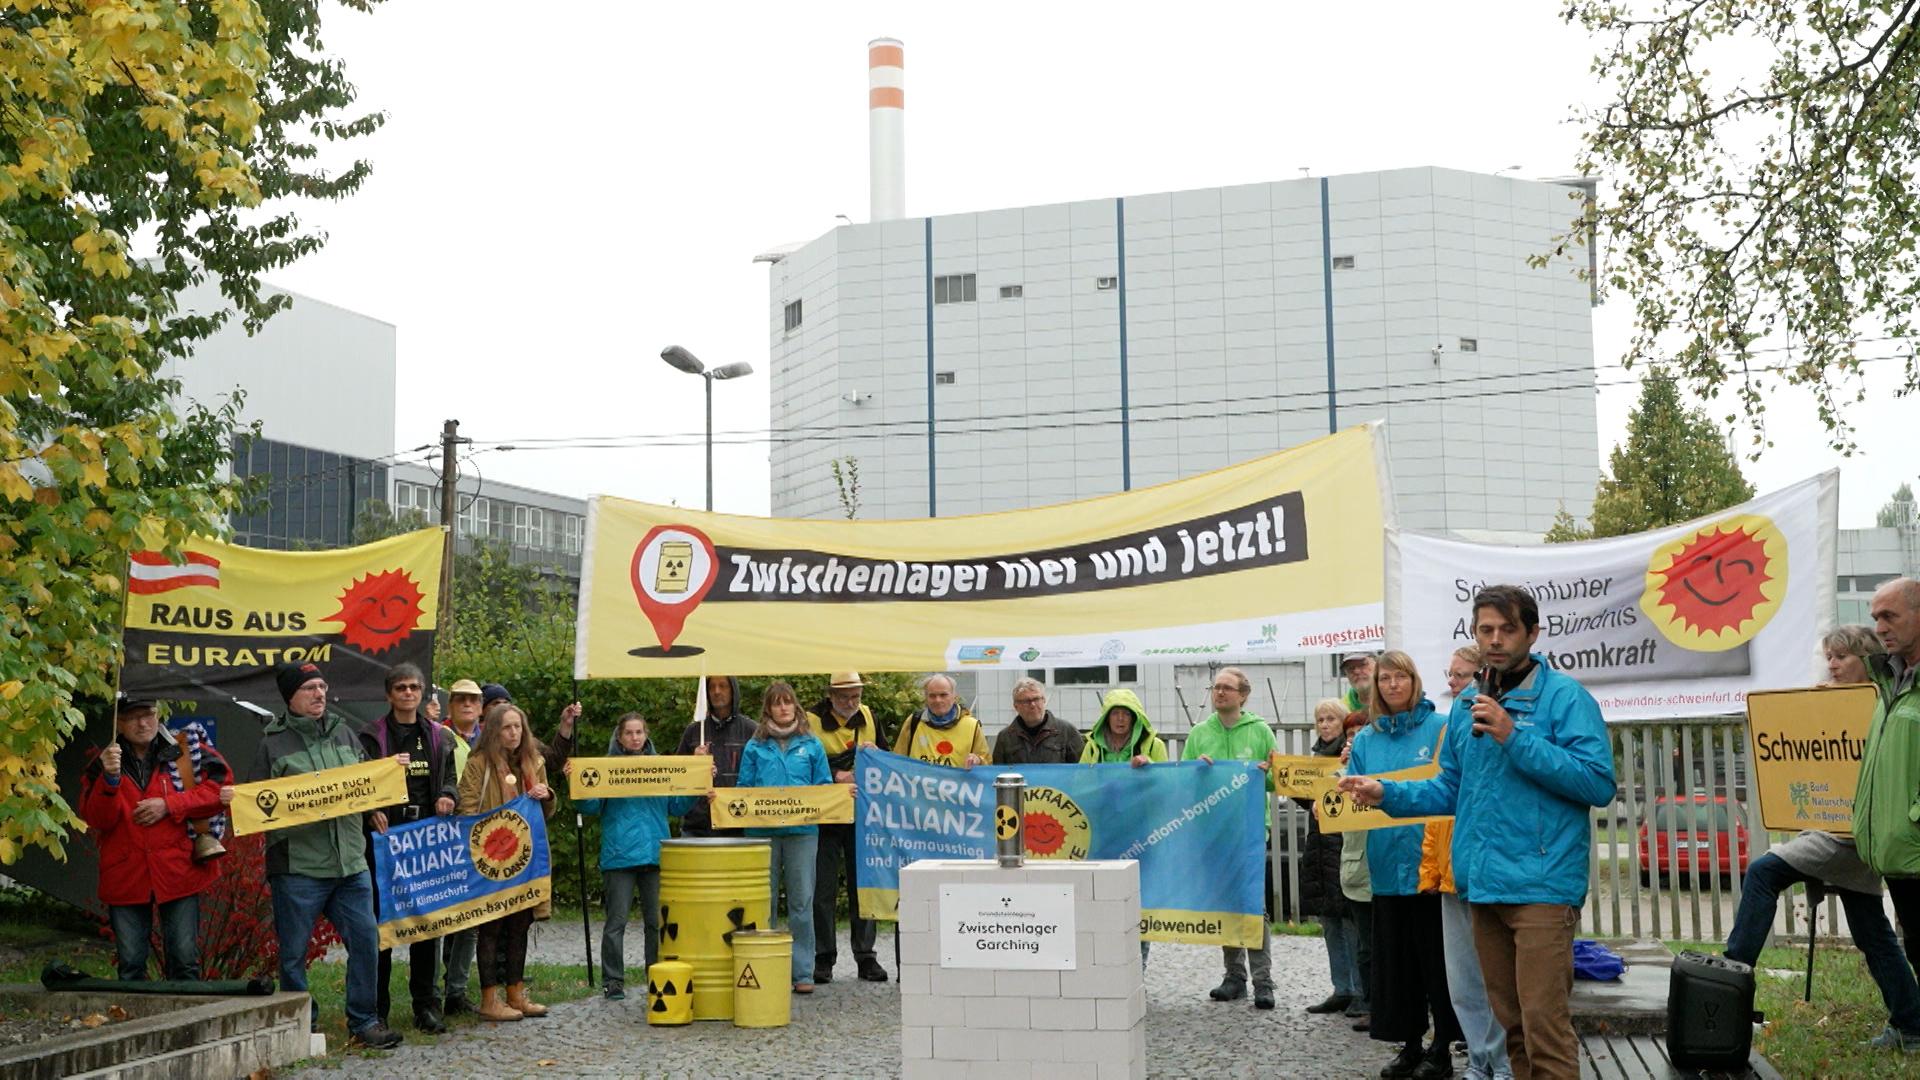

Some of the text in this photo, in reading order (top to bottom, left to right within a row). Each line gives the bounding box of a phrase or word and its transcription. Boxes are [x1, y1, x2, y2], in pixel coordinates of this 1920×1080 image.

[729, 554, 990, 598] Zwischenlager
[1089, 535, 1168, 581] und
[1177, 505, 1287, 575] jetzt!
[150, 603, 307, 632] RAUS AUS
[148, 642, 332, 667] EURATOM
[1538, 637, 1658, 671] tomkraft
[1757, 730, 1866, 762] Schweinfu
[608, 766, 688, 776] VERANTWORTUNG
[608, 776, 671, 786] ÜBERNEHMEN!
[864, 766, 985, 809] BAYERN
[288, 801, 305, 812] UM
[754, 798, 804, 806] ATOMMÜLL
[754, 807, 821, 816] ENTSCHÄRFEN!
[1119, 771, 1250, 860] anti-atom-bayern.de
[865, 801, 985, 839] ALLIANZ
[388, 821, 462, 857] BAYERN
[865, 833, 985, 861] für Atomausstieg
[392, 845, 466, 881] ALLIANZ
[476, 843, 532, 878] NEIN DANKE
[865, 854, 893, 868] und
[391, 868, 469, 896] für Atomausstieg
[394, 883, 470, 913] und Klimaschutz
[395, 886, 541, 939] www.anti-atom-bayern.de
[1139, 916, 1222, 935] giewende!
[958, 921, 1059, 937] Zwischenlager
[976, 939, 1040, 954] Garching
